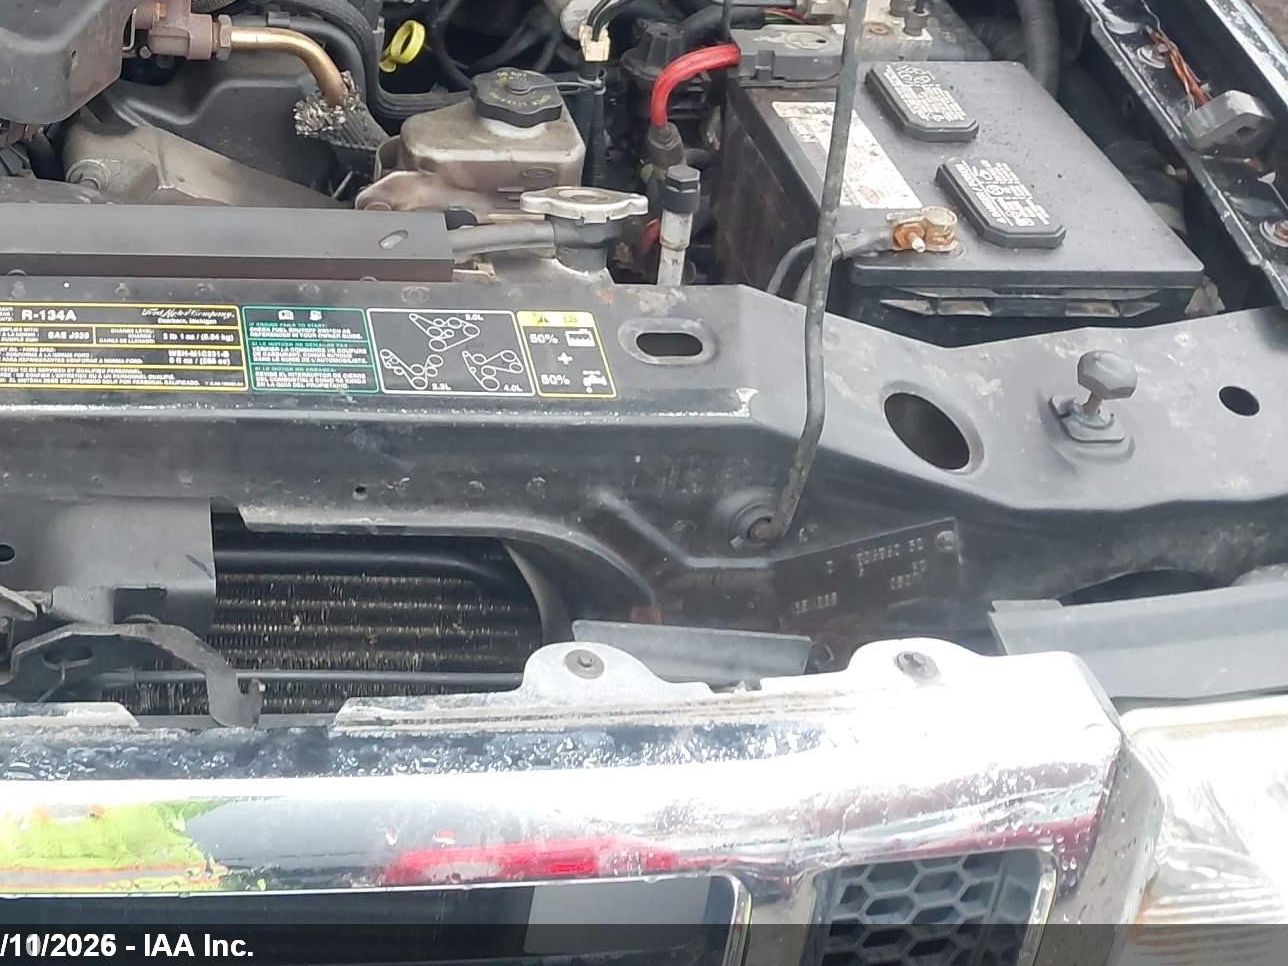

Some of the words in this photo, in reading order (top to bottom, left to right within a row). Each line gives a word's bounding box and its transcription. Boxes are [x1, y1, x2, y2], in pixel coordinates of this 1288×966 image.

[21, 309, 77, 322] R-134A
[529, 333, 559, 345] 50%
[540, 374, 571, 385] 50%
